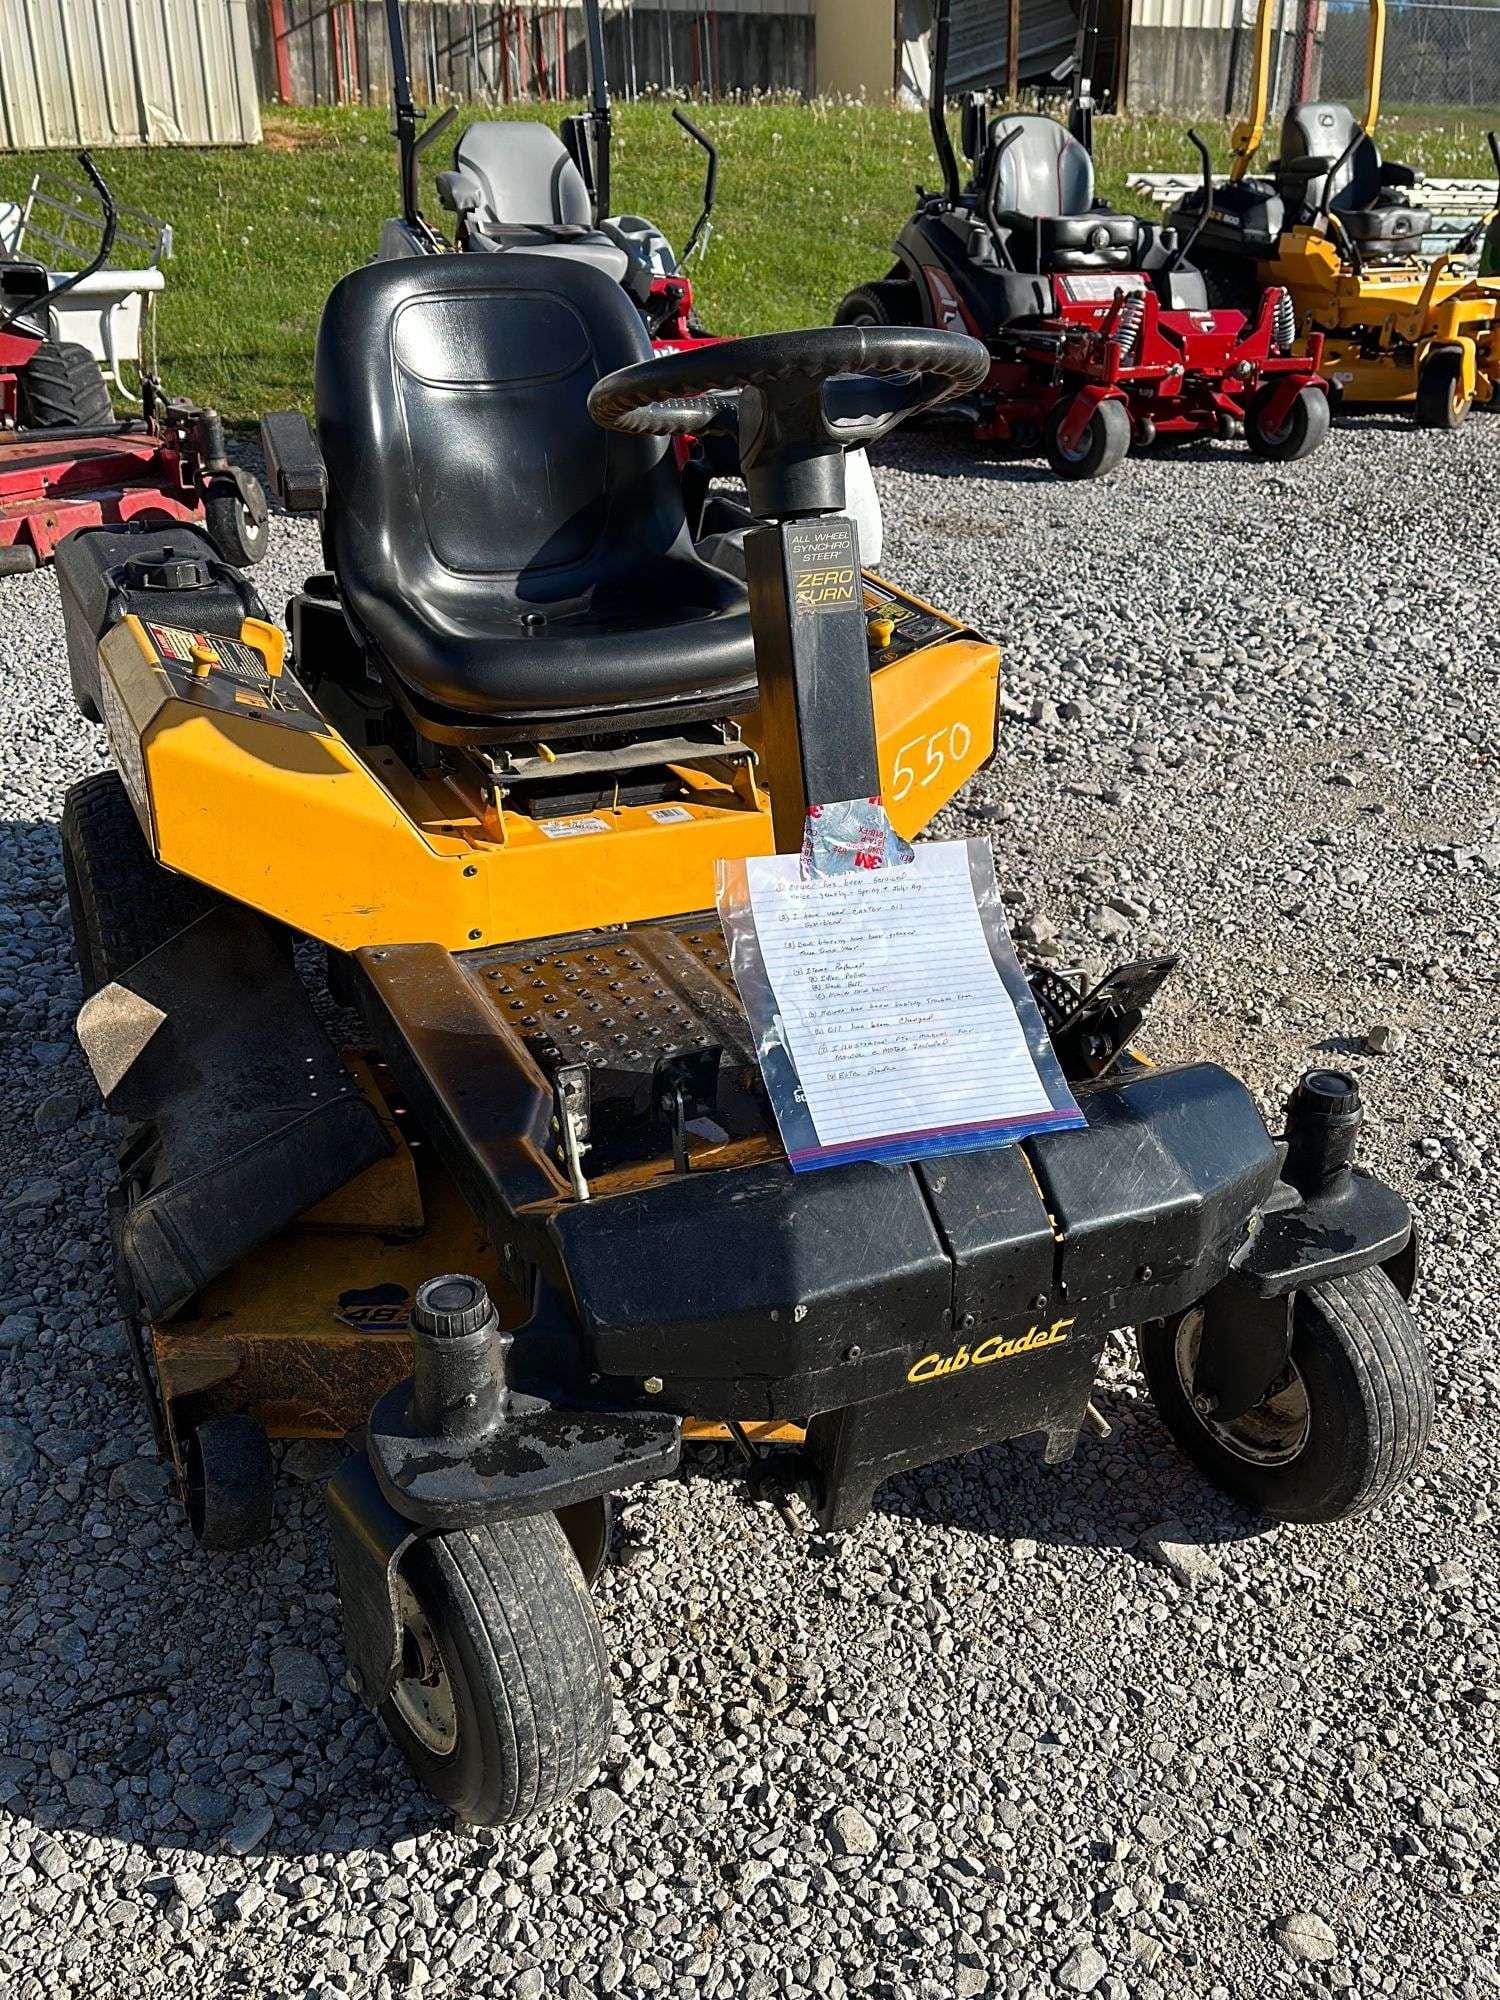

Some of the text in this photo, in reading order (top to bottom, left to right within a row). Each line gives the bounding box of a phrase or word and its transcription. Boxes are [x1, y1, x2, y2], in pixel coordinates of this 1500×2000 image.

[792, 531, 849, 544] ALL WHEEL
[792, 541, 850, 553] SYNCHRO
[803, 551, 839, 562] STEER
[796, 570, 854, 588] ZERO
[892, 722, 971, 801] 550
[907, 1317, 1077, 1383] Cub Cadet
